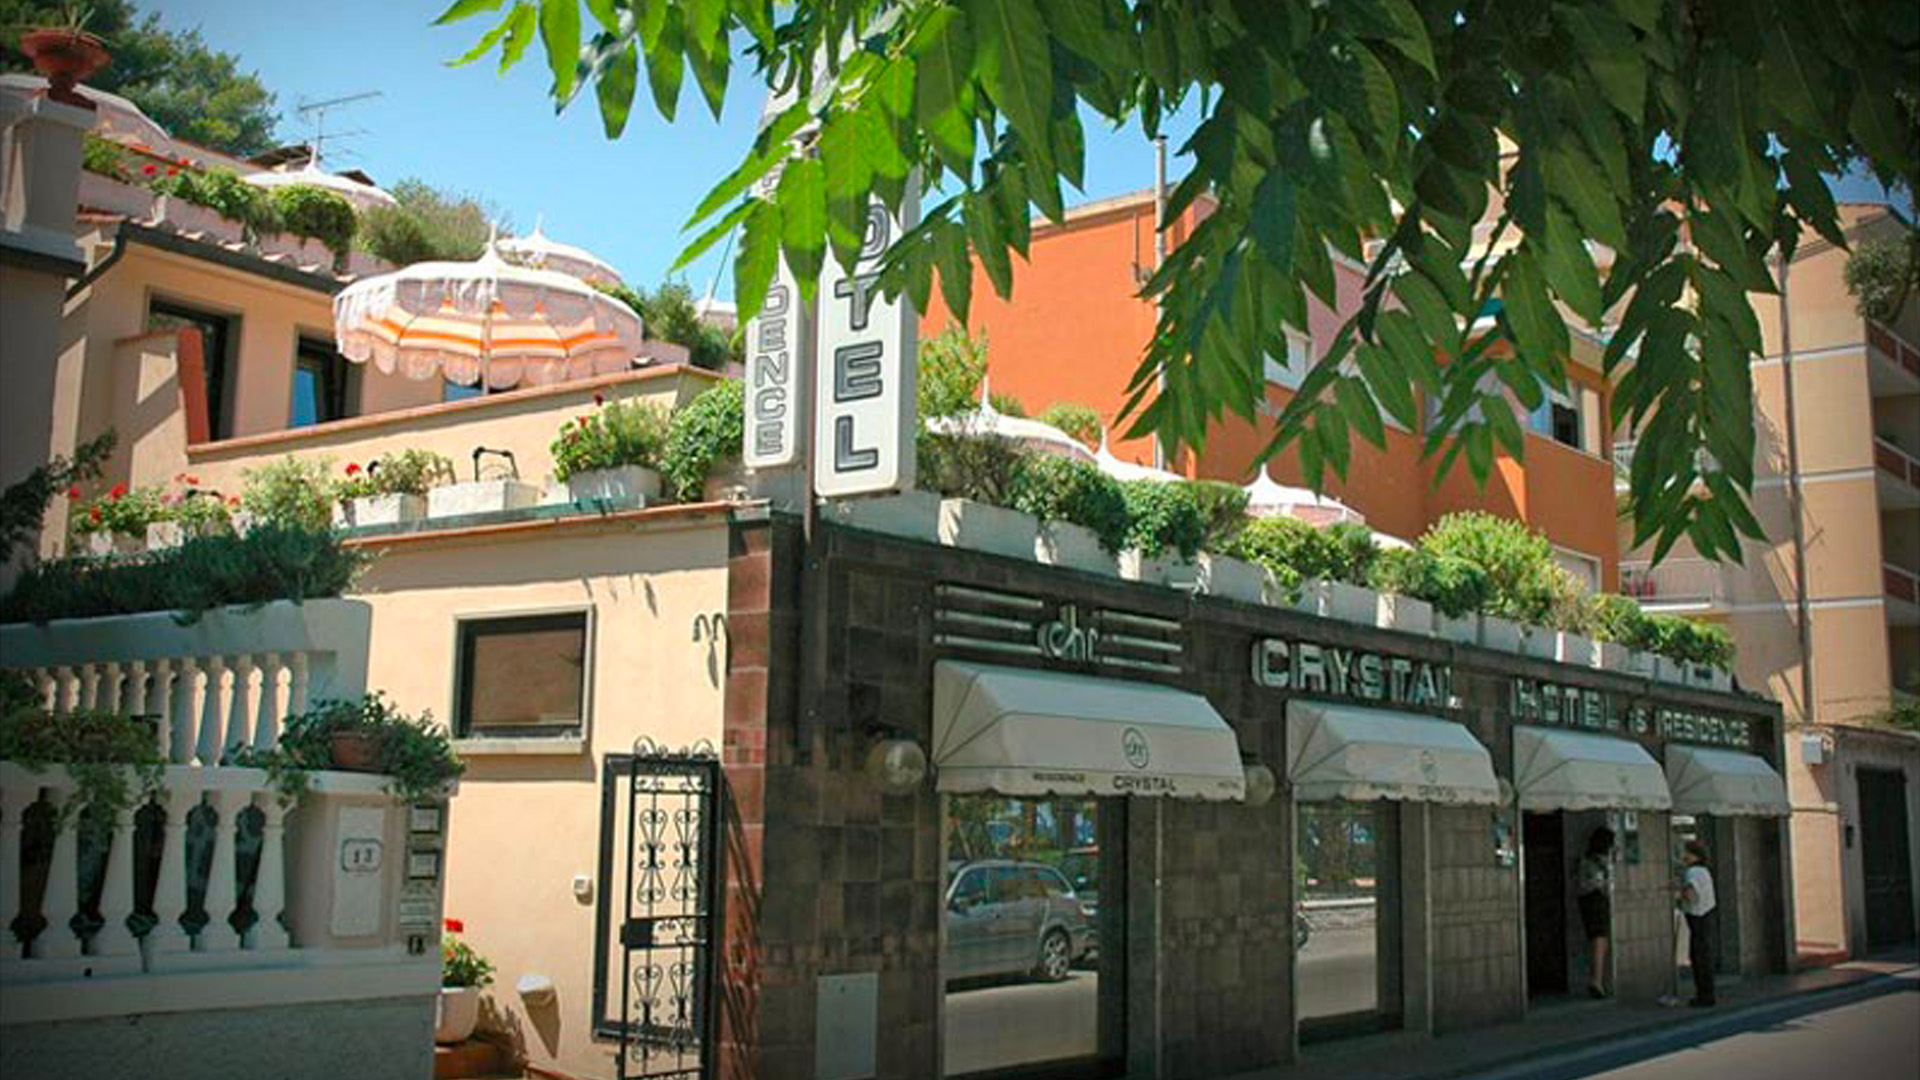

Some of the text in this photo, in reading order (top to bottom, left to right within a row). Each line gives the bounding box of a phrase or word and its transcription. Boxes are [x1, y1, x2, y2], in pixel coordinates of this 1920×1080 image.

[834, 203, 891, 473] OTEL
[1251, 637, 1462, 709] CRYSTAL
[1511, 677, 1618, 728] HOTEL
[1656, 708, 1750, 747] RESIDENCE
[1112, 774, 1177, 792] CRYSTAL
